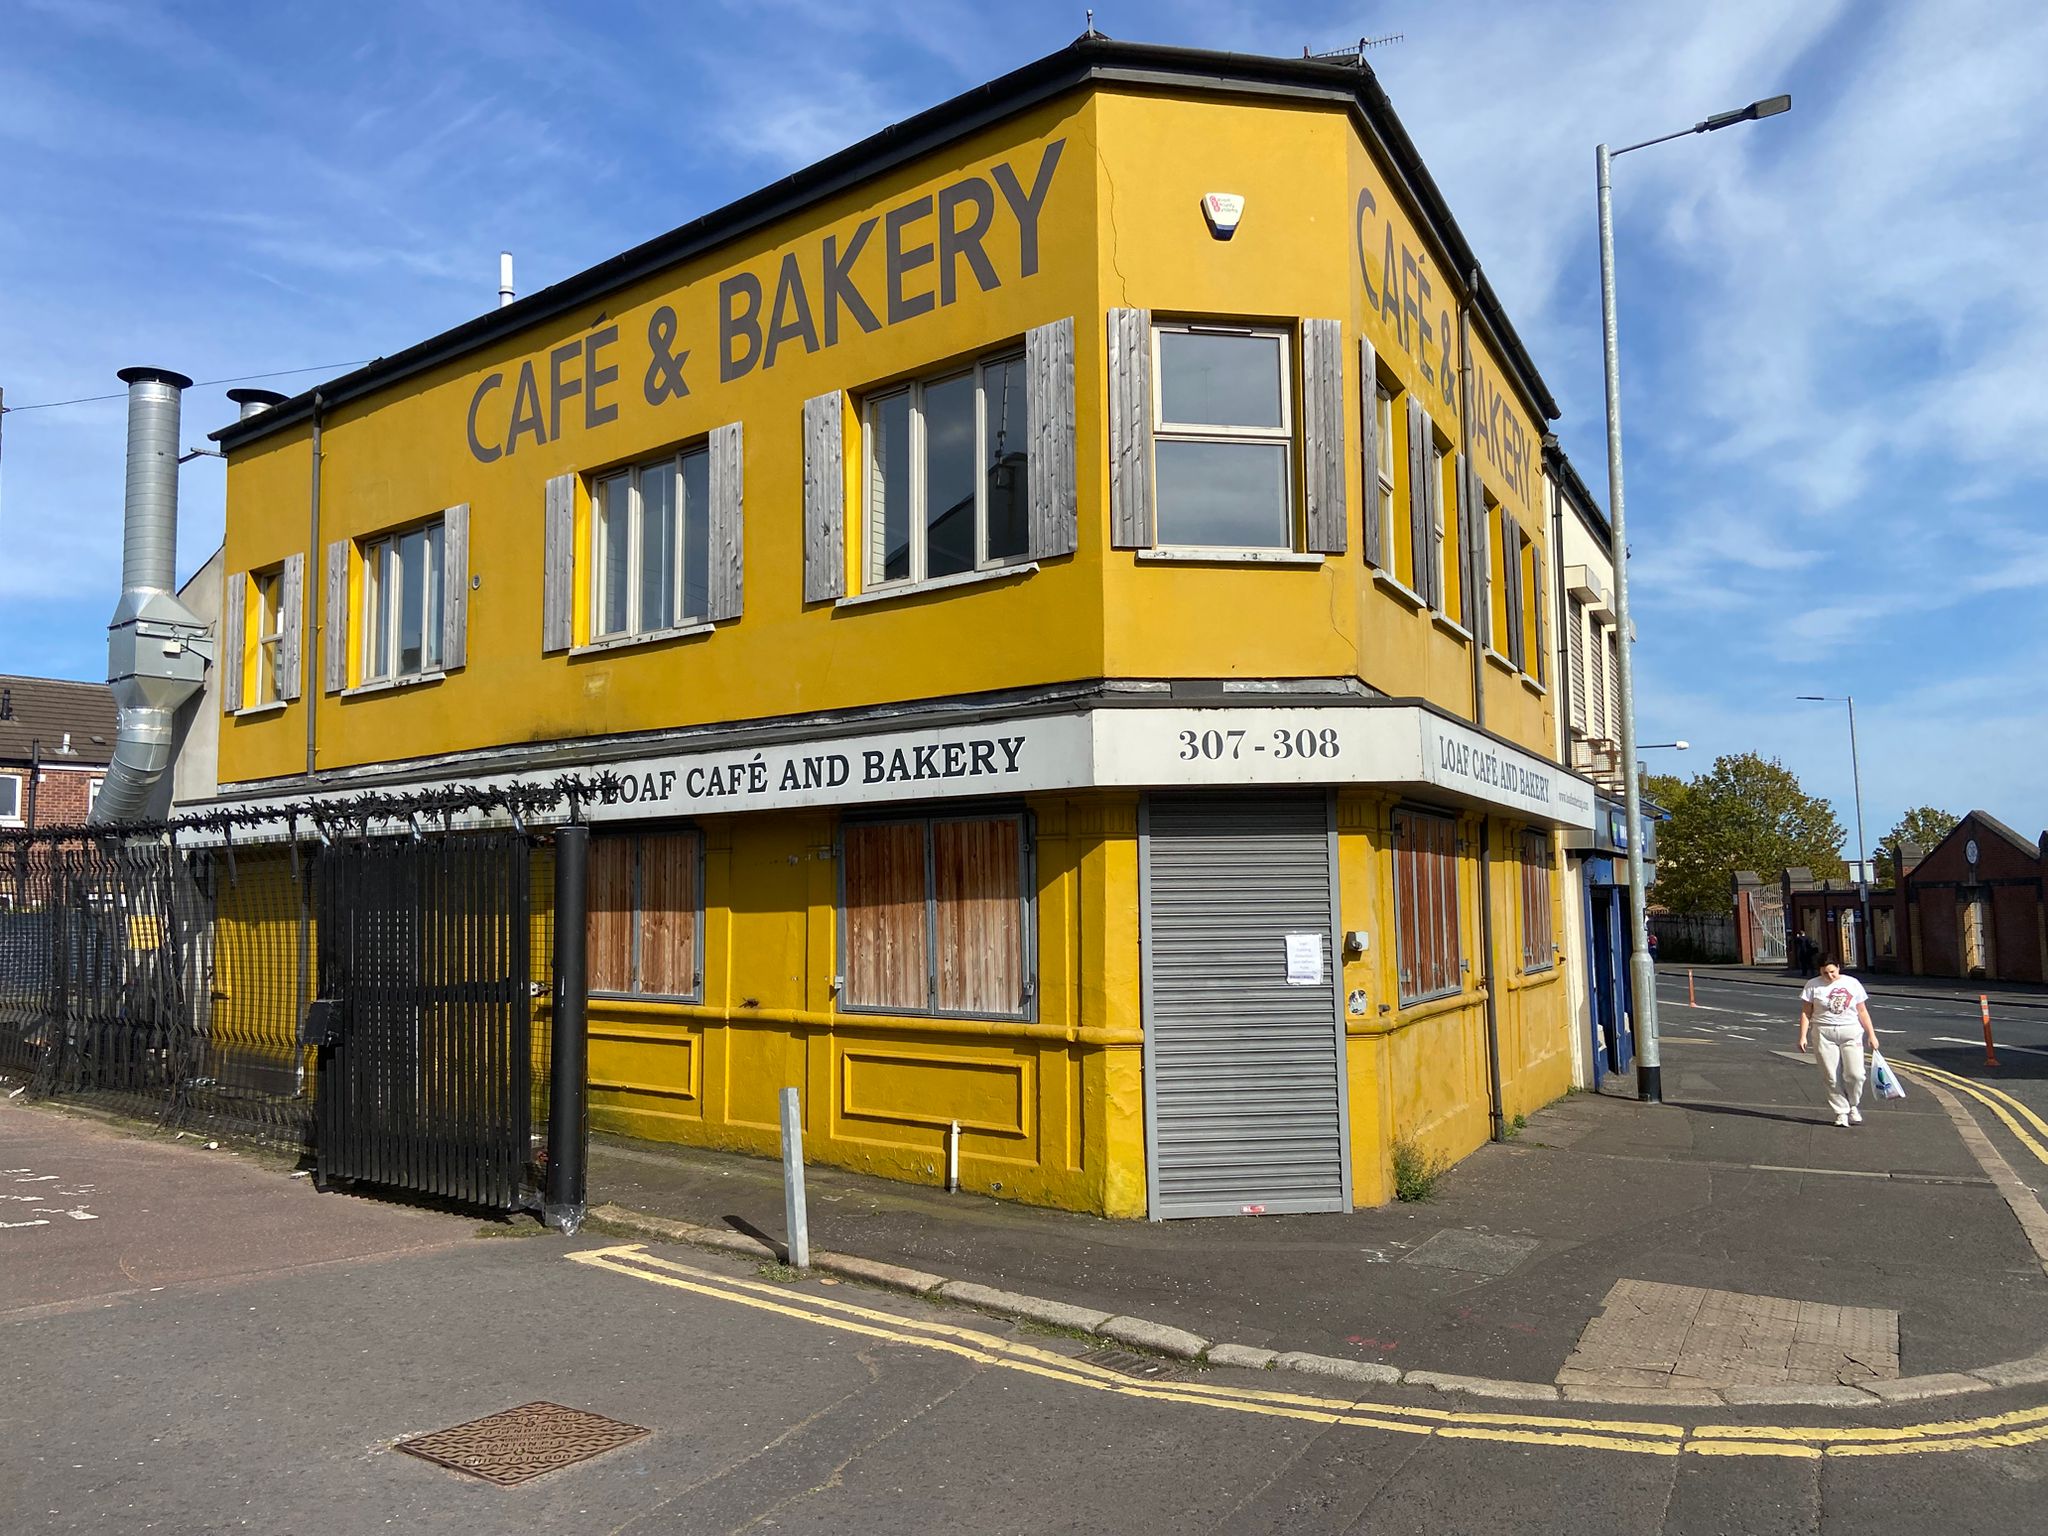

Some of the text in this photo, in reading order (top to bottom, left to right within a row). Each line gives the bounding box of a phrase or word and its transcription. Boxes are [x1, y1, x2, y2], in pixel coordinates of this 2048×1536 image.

[467, 137, 1067, 463] CAFÉ & BAKERY
[1356, 187, 1434, 386] CAFÉ
[1440, 310, 1457, 417] &
[686, 753, 768, 797] CAFÉ
[779, 755, 850, 792] AND
[863, 737, 1026, 784] BAKERY
[1440, 736, 1469, 776] LOAF
[1473, 748, 1498, 787] CAFÉ
[1500, 761, 1518, 792] AND
[1520, 768, 1549, 803] BAKERY
